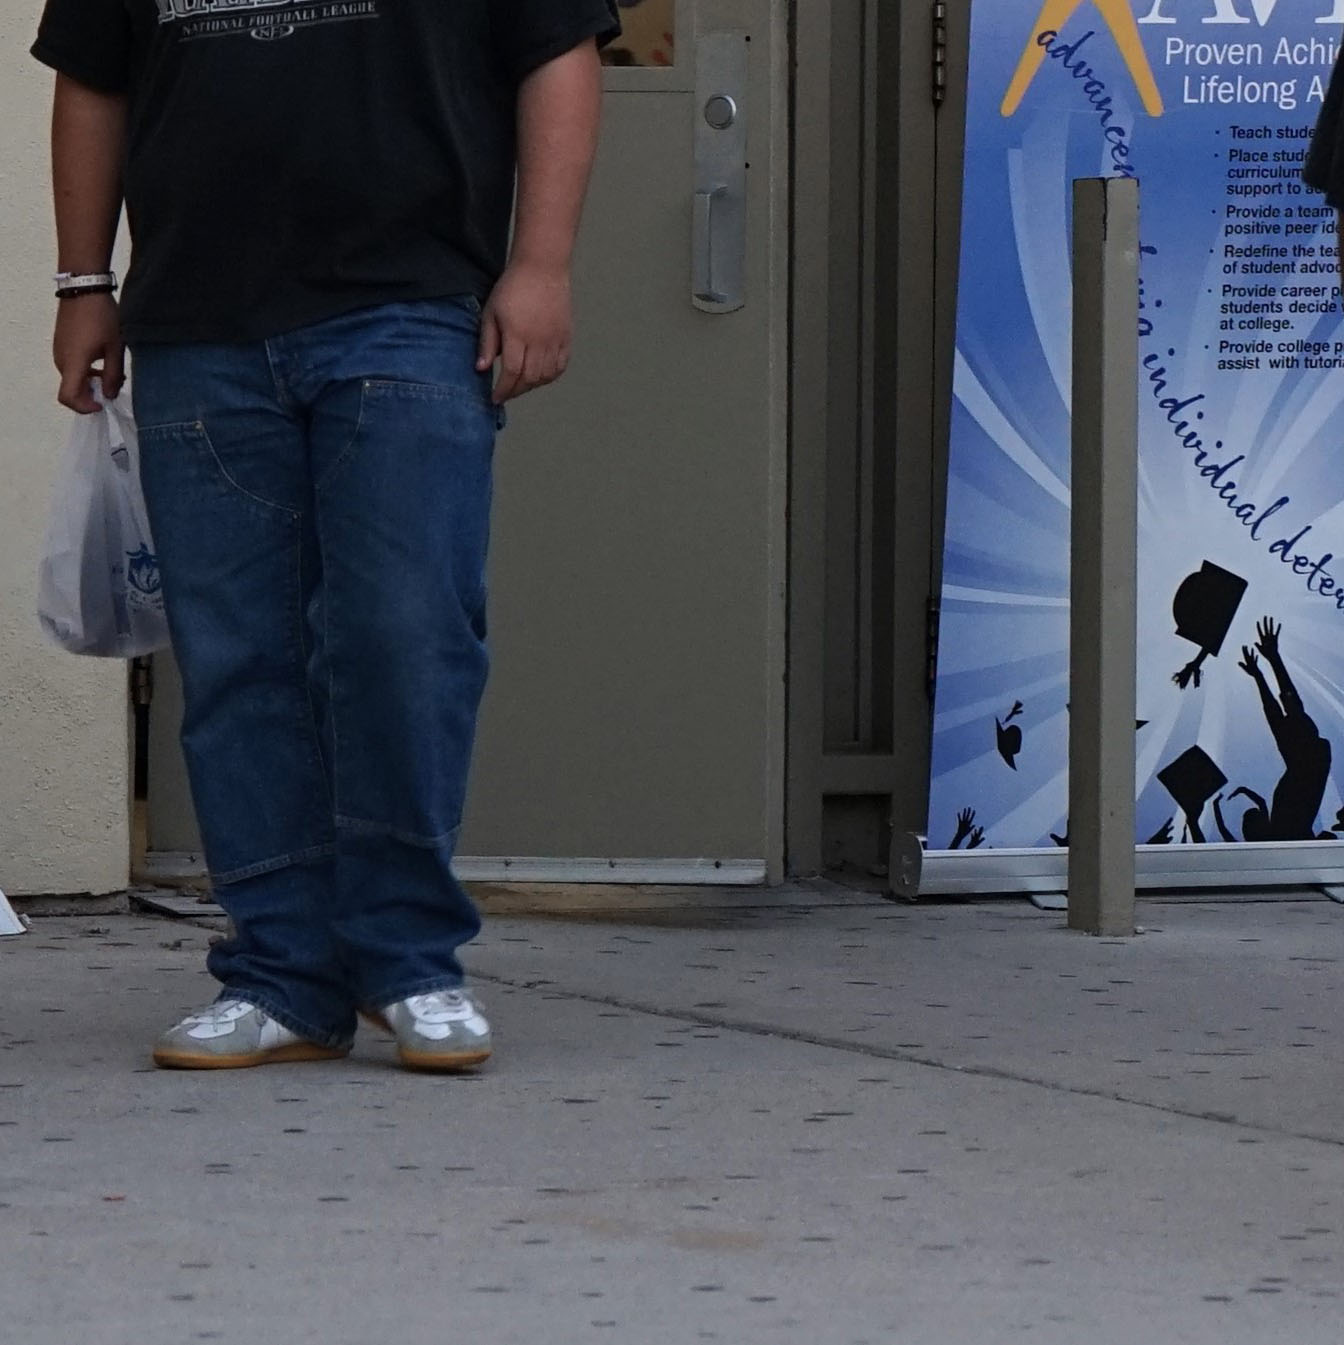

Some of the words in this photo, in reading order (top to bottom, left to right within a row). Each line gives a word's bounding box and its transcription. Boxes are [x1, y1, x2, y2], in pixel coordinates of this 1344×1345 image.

[182, 14, 244, 37] NATIONAL
[248, 7, 318, 28] FOOTBALL
[321, 1, 377, 18] LEAGUE
[1165, 36, 1263, 66] Proven
[1272, 36, 1343, 66] Achi
[1183, 74, 1298, 111] Lifelong
[1306, 74, 1326, 104] A
[1229, 125, 1273, 139] Teach
[1275, 125, 1316, 139] stude
[1229, 149, 1269, 163] Place
[1226, 182, 1283, 197] support
[1287, 182, 1302, 195] to
[1226, 204, 1280, 218] Provide
[1284, 207, 1293, 218] a
[1297, 205, 1334, 218] team
[1225, 221, 1281, 237] positive
[1285, 223, 1319, 237] peer
[1224, 244, 1288, 258] Redefine
[1292, 244, 1316, 257] the
[1319, 245, 1341, 257] tea
[1222, 261, 1238, 275] of
[1241, 261, 1297, 274] student
[1299, 260, 1342, 274] advoc
[1222, 284, 1277, 298] Provide
[1280, 286, 1328, 298] career
[1220, 301, 1283, 314] students
[1288, 301, 1337, 314] decide
[1219, 318, 1234, 330] at
[1238, 316, 1295, 333] college.
[1219, 340, 1274, 354] Provide
[1277, 339, 1330, 355] college
[1217, 357, 1260, 370] assist
[1268, 356, 1299, 369] with
[1142, 347, 1291, 542] individual
